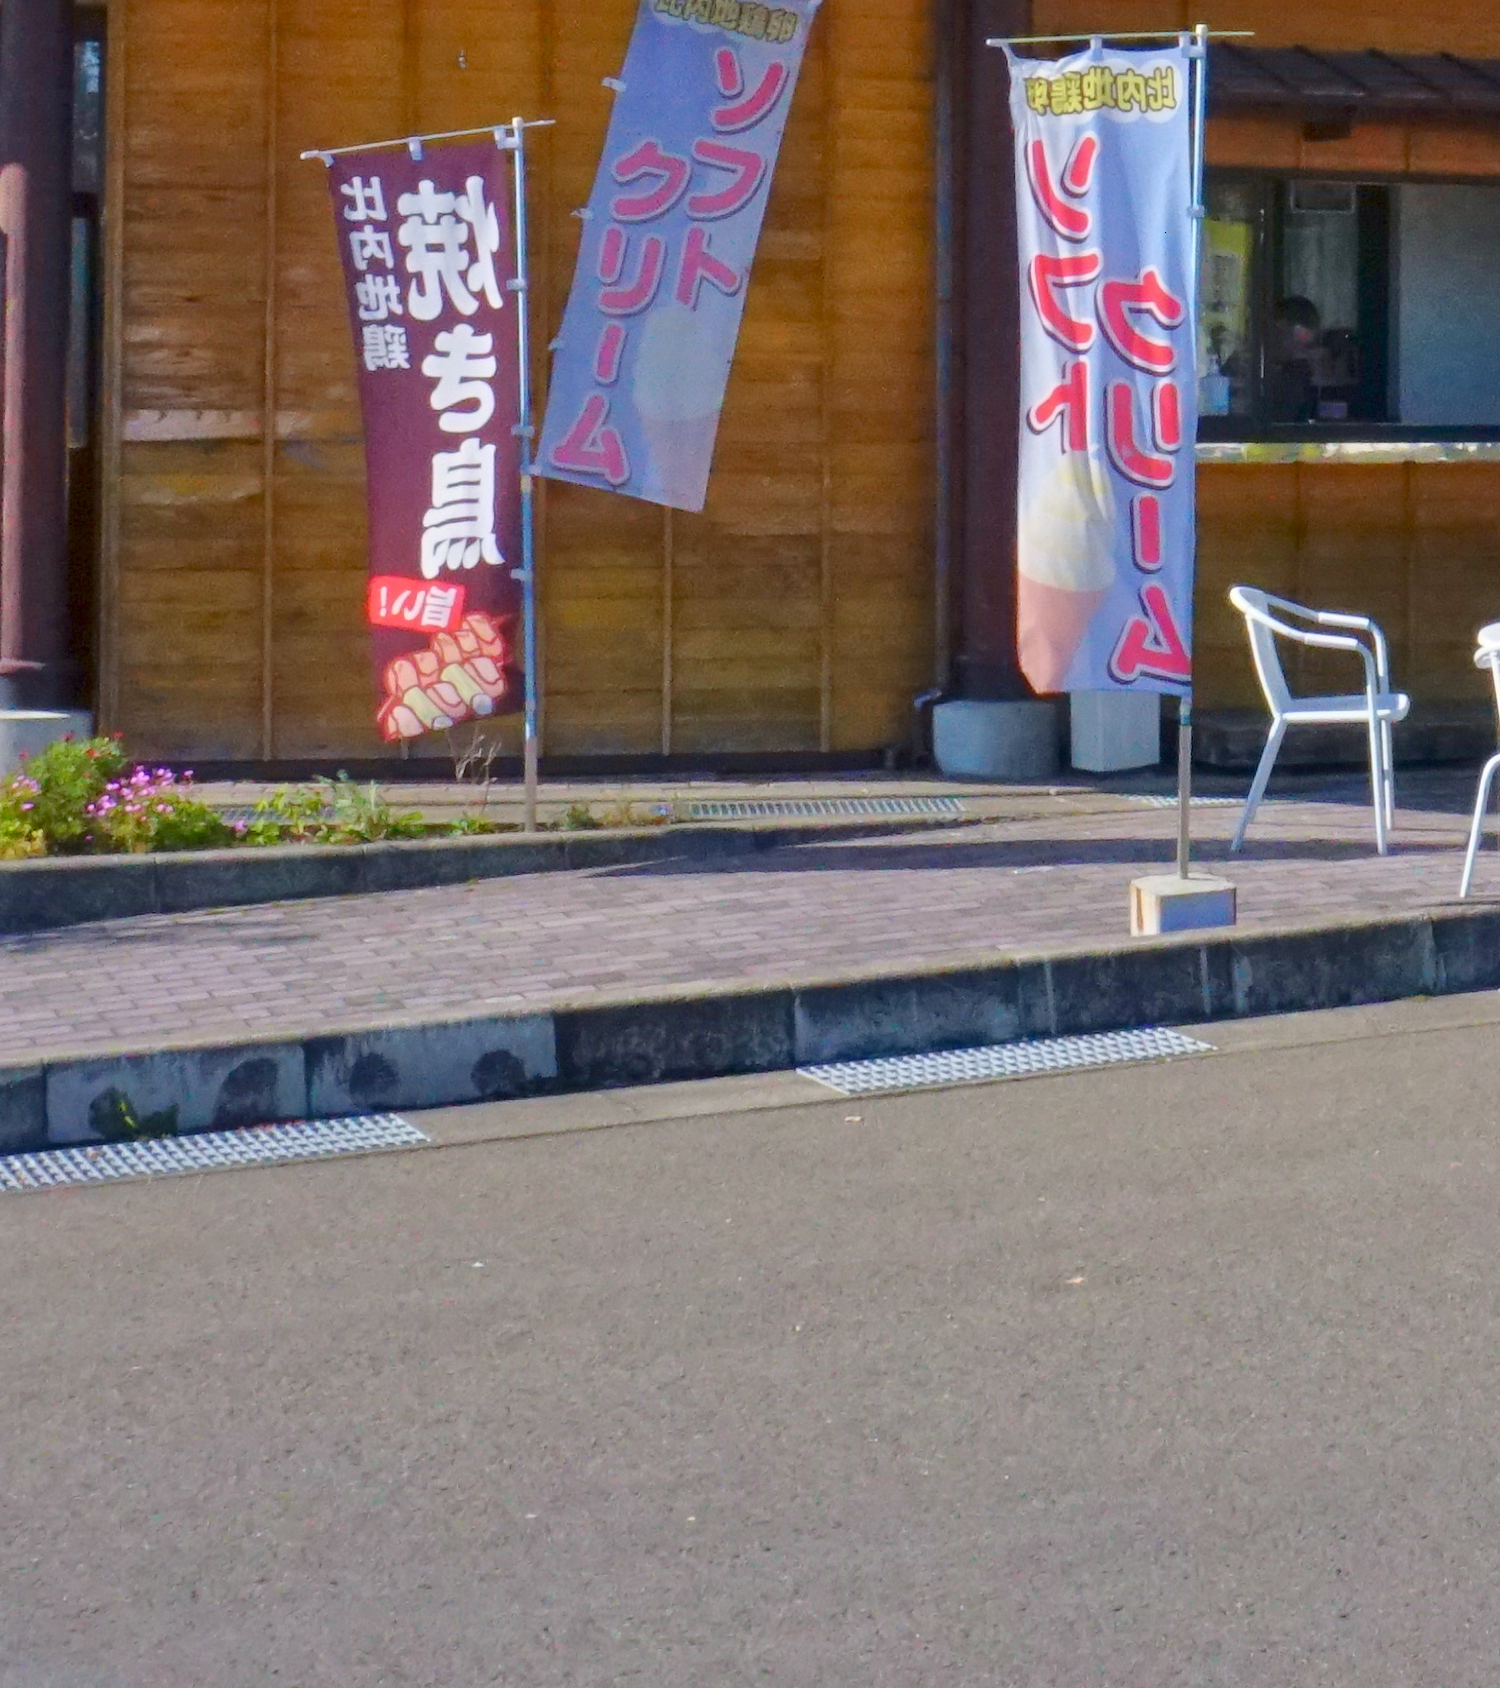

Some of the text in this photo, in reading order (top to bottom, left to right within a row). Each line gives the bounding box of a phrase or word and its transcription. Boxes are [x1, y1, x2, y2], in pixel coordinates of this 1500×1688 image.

[550, 139, 693, 486] クリーム
[674, 46, 787, 311] ソフト
